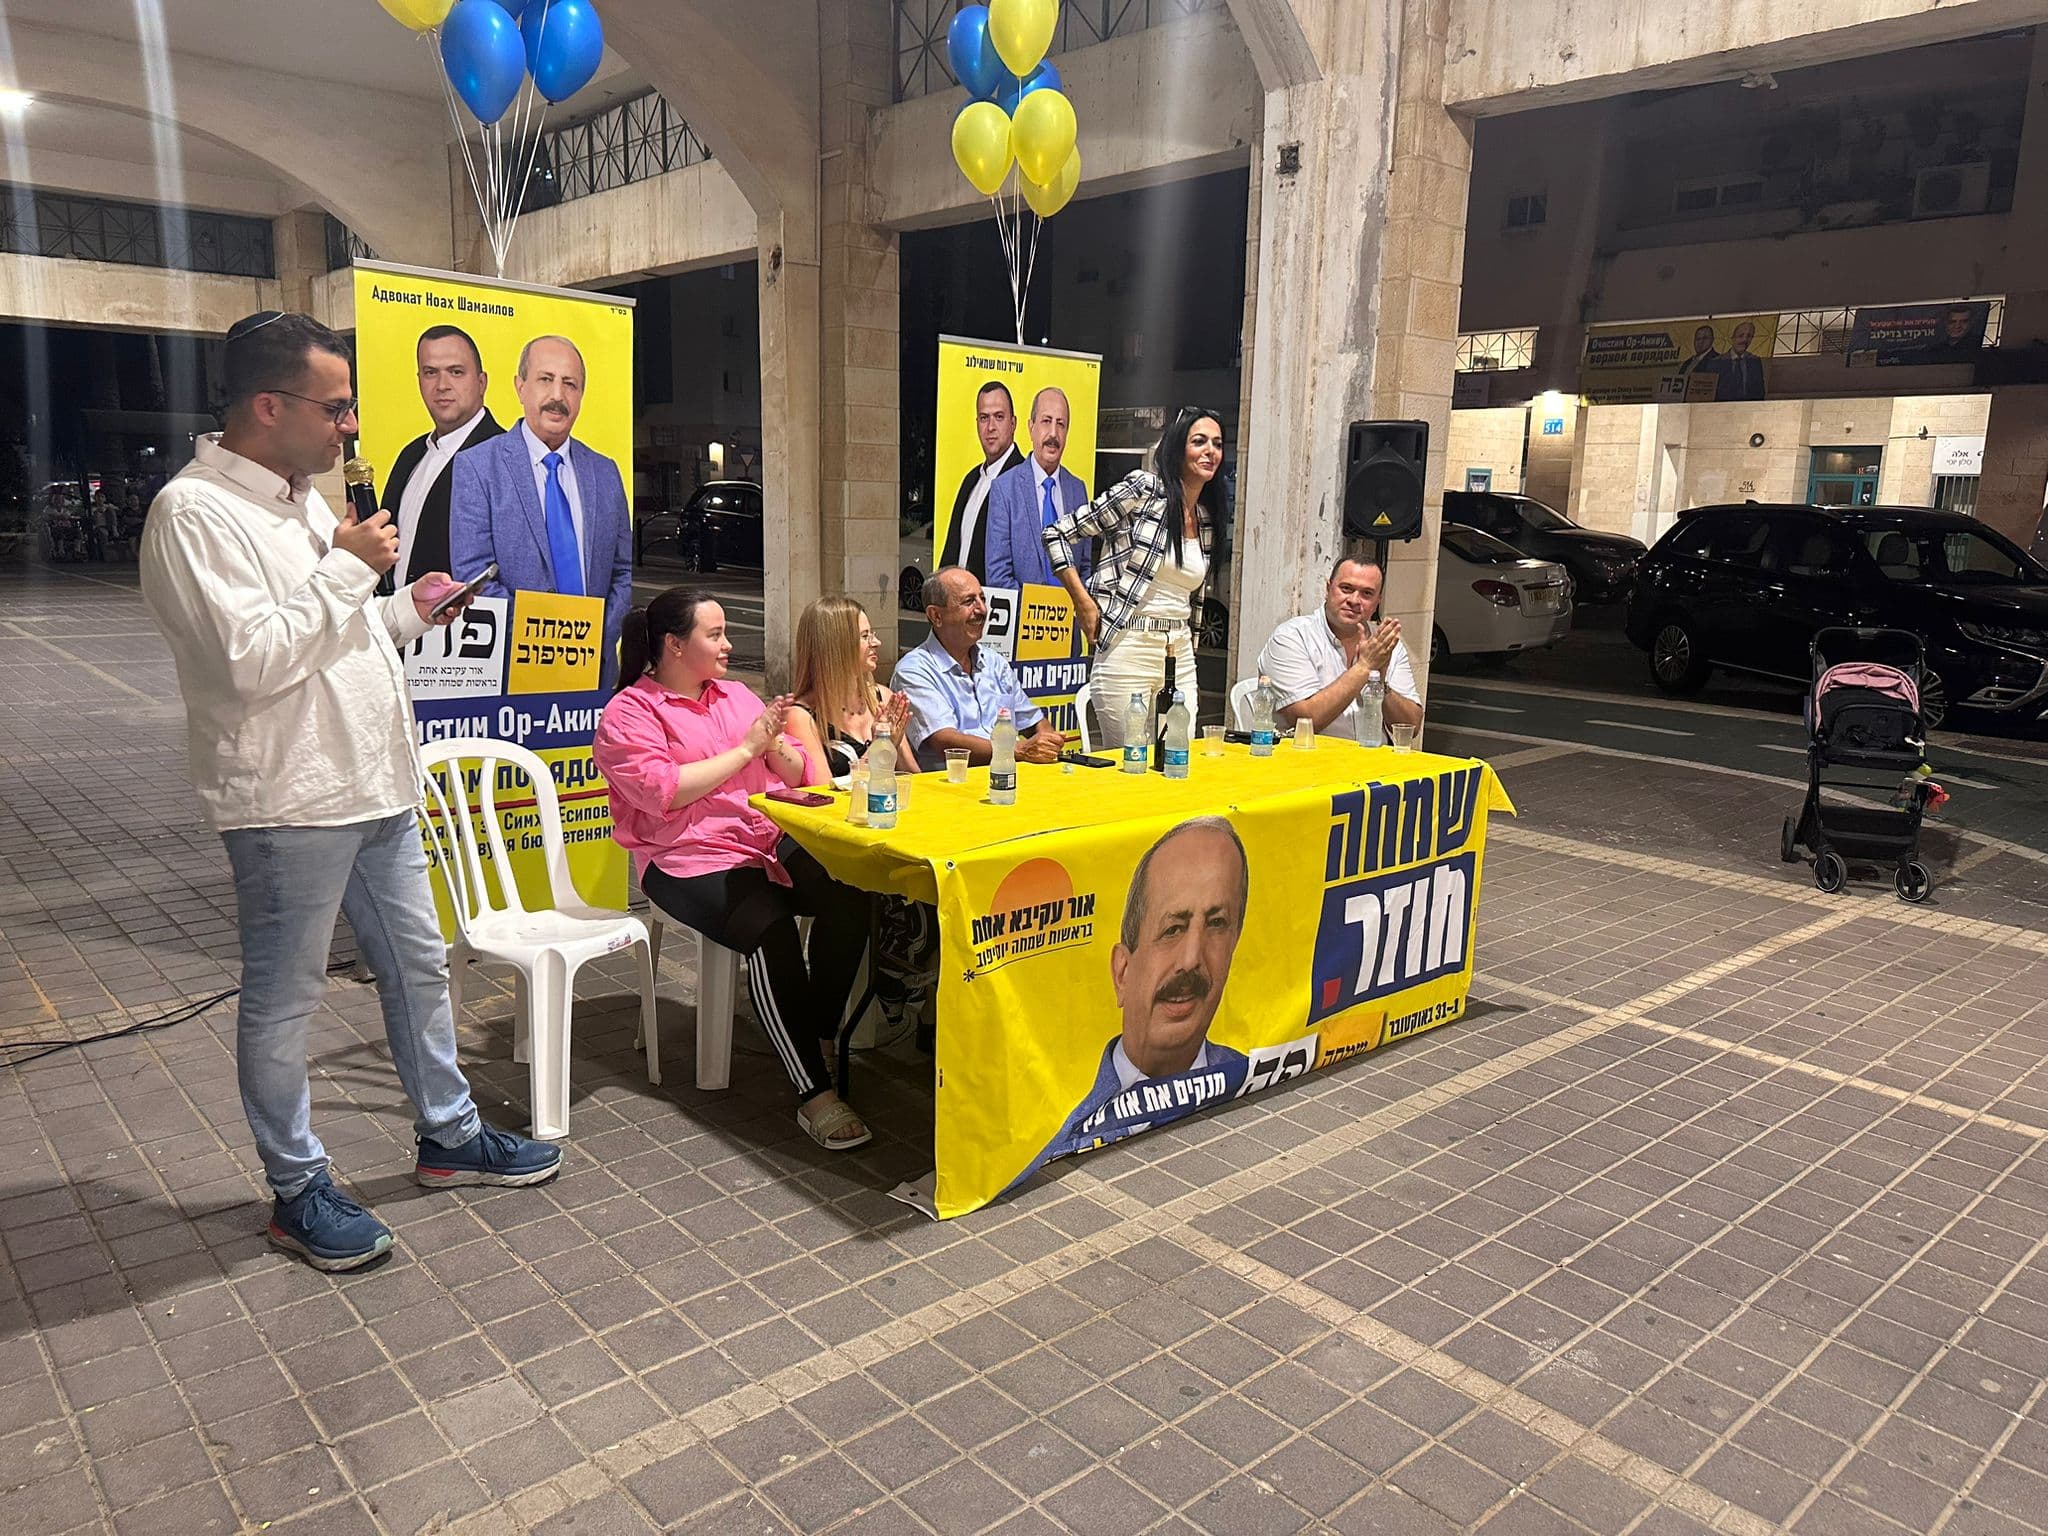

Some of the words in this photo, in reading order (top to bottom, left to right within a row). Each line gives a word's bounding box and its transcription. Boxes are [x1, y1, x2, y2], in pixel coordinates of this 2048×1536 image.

[372, 284, 422, 305] Адвокат
[426, 292, 454, 309] Ноах
[457, 296, 514, 317] Шамаилов
[1544, 423, 1561, 433] 514
[987, 595, 1011, 636] פ
[1027, 604, 1067, 621] שמחה
[526, 617, 591, 640] שמחה
[1022, 624, 1069, 642] יוסיפוב
[516, 643, 594, 666] יוסיפוב
[419, 666, 438, 674] אחת
[1022, 665, 1043, 689] את
[1046, 663, 1087, 690] מנקים
[559, 805, 612, 824] Есипов
[1325, 766, 1483, 882] שמחה
[1009, 900, 1064, 933] עקיבא
[1067, 893, 1095, 918] אור
[972, 913, 1005, 945] אחת
[1048, 923, 1093, 945] בראשות
[976, 942, 1008, 968] יוסיפוב
[1011, 933, 1045, 954] שמחה
[1389, 1006, 1433, 1037] באוקטובר
[1143, 1082, 1174, 1113] את
[1173, 1072, 1226, 1107] מנקים
[1112, 1093, 1143, 1119] אור
